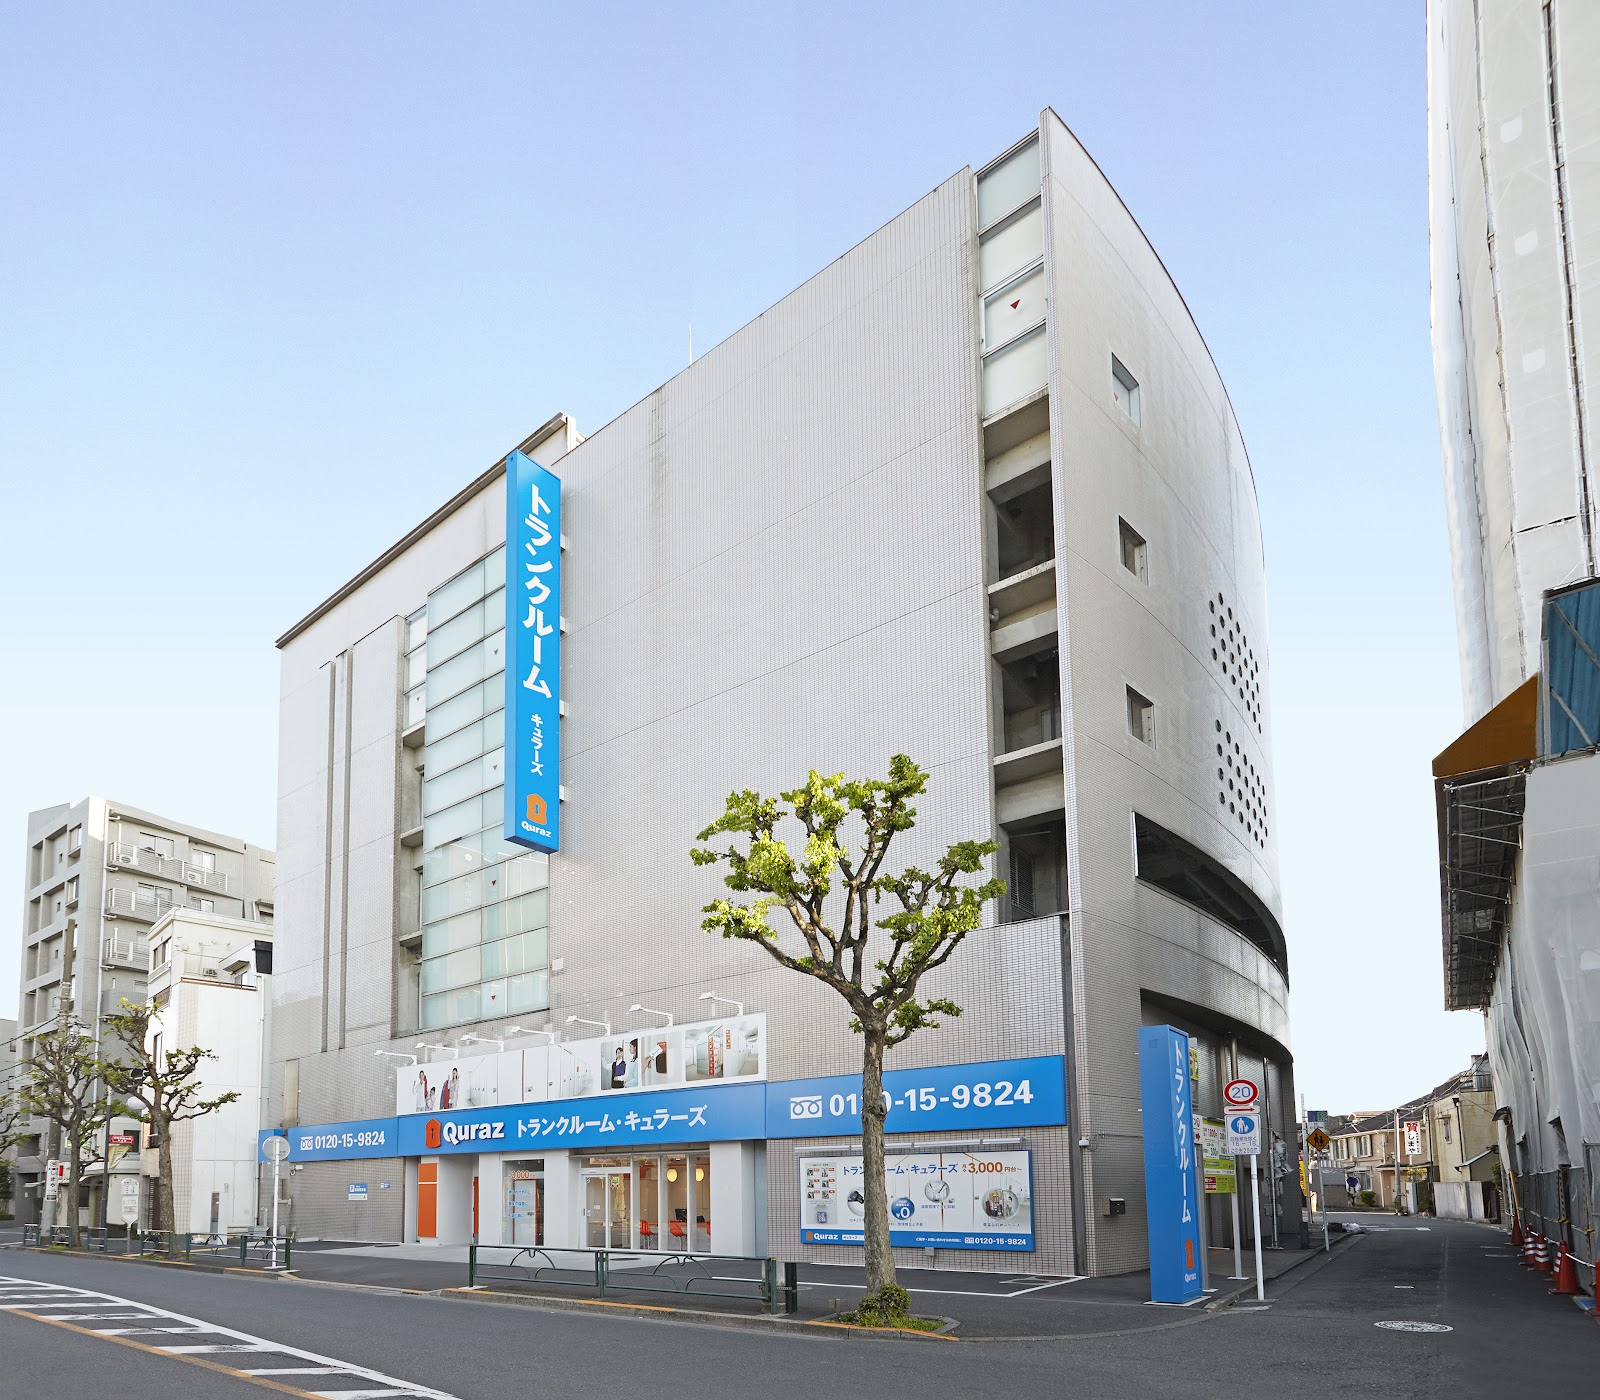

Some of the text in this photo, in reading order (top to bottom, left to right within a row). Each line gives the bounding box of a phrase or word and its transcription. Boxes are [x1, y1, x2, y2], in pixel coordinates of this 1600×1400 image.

[522, 484, 554, 699] トランクルーム
[529, 713, 544, 777] キュラーズ
[520, 819, 552, 838] Quraz
[829, 1080, 1034, 1116] 010-15-9824
[1231, 1086, 1251, 1099] 20
[442, 1104, 708, 1146] Quraz トランクルーム・キュラーズ
[1175, 1040, 1192, 1224] トランクルーム
[314, 1130, 386, 1150] 0120-15-9824
[813, 1232, 838, 1241] Quraz
[974, 1237, 1027, 1246] 0120-15-9824
